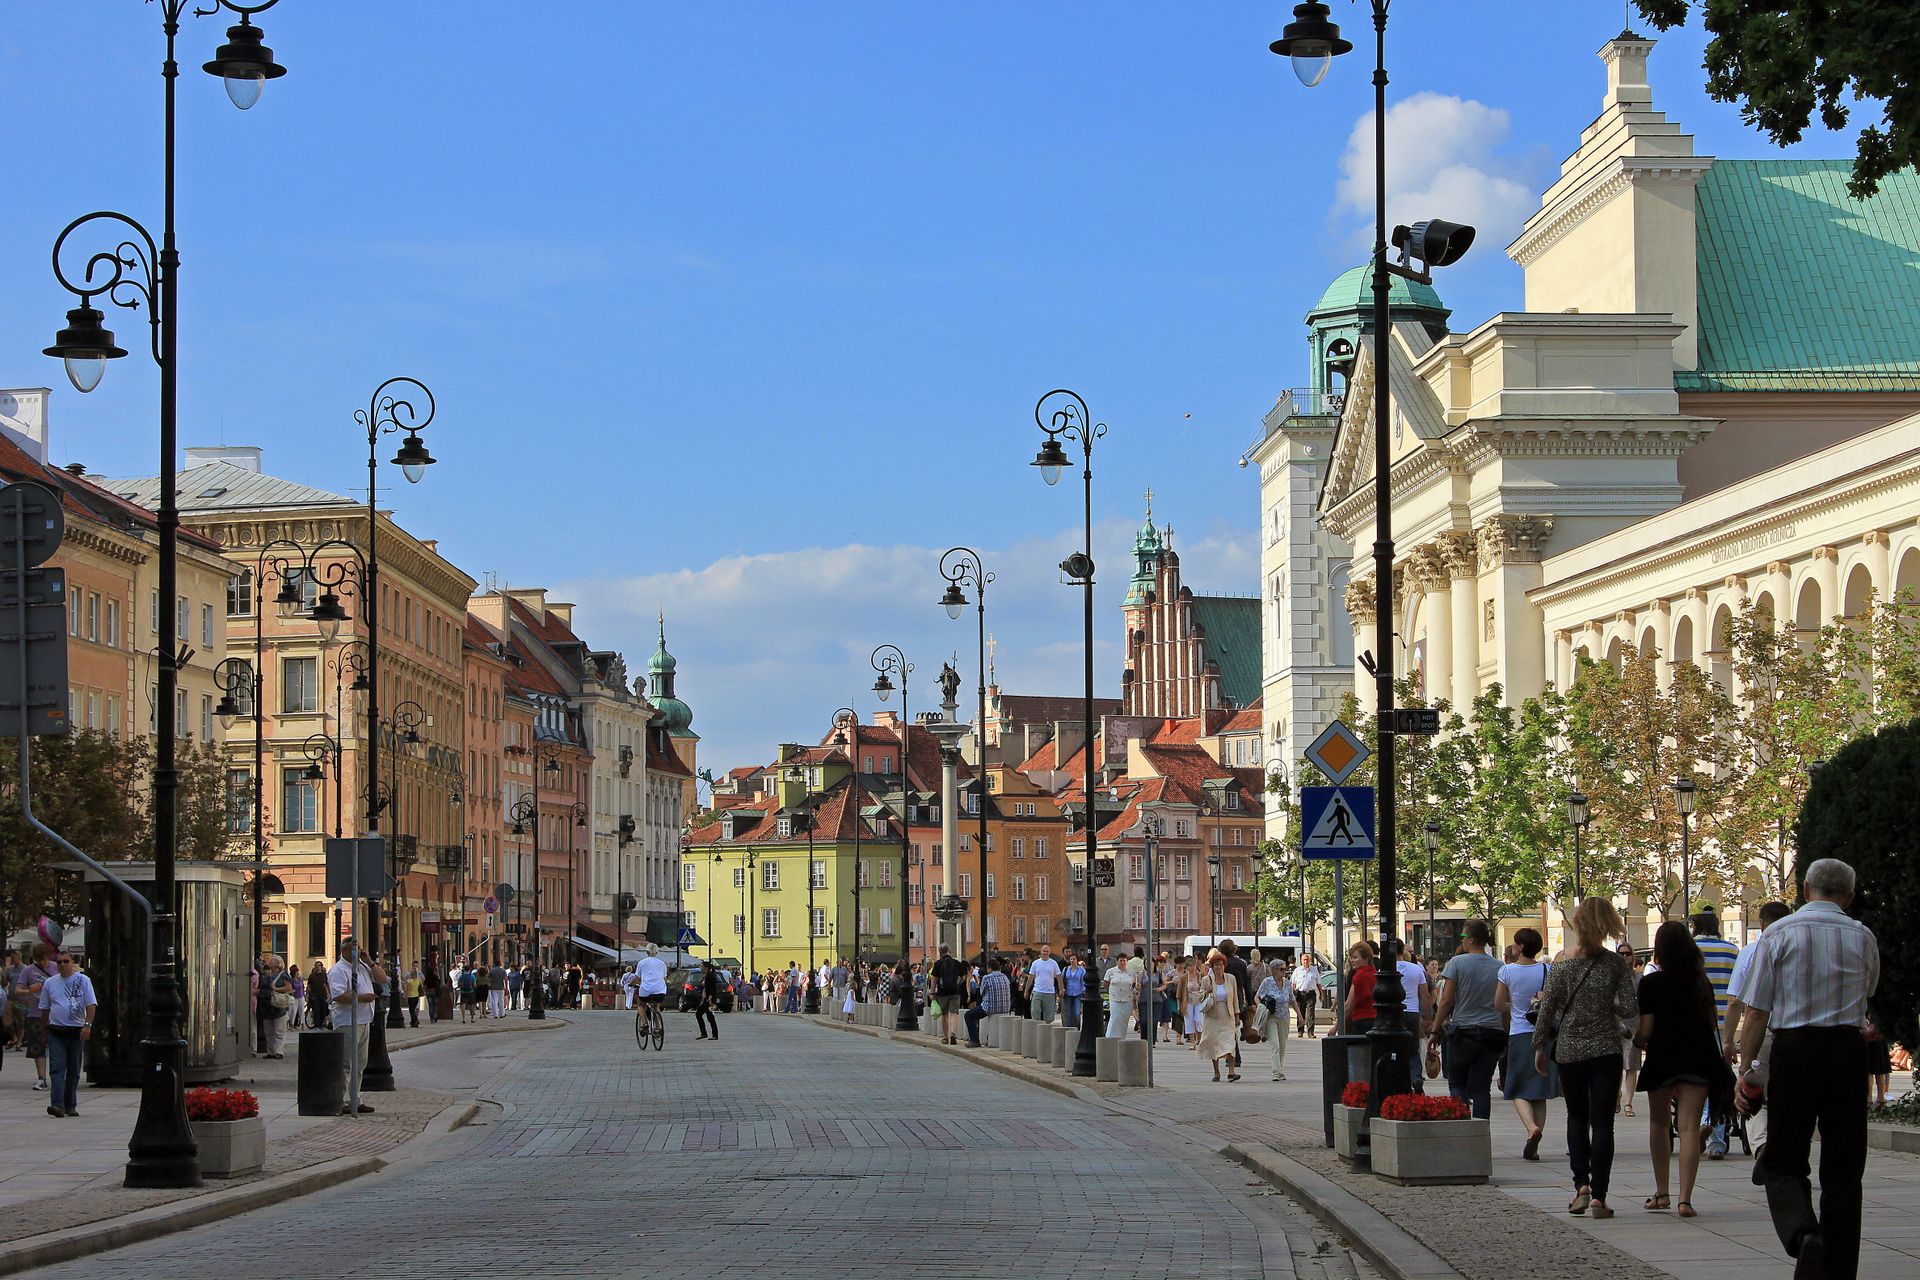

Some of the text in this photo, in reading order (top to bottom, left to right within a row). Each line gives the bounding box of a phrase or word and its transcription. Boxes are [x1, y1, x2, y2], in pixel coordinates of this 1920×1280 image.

[1740, 532, 1769, 555] BIBLIOTEKA
[1770, 524, 1797, 544] ROLNICZA
[1095, 876, 1107, 886] WC
